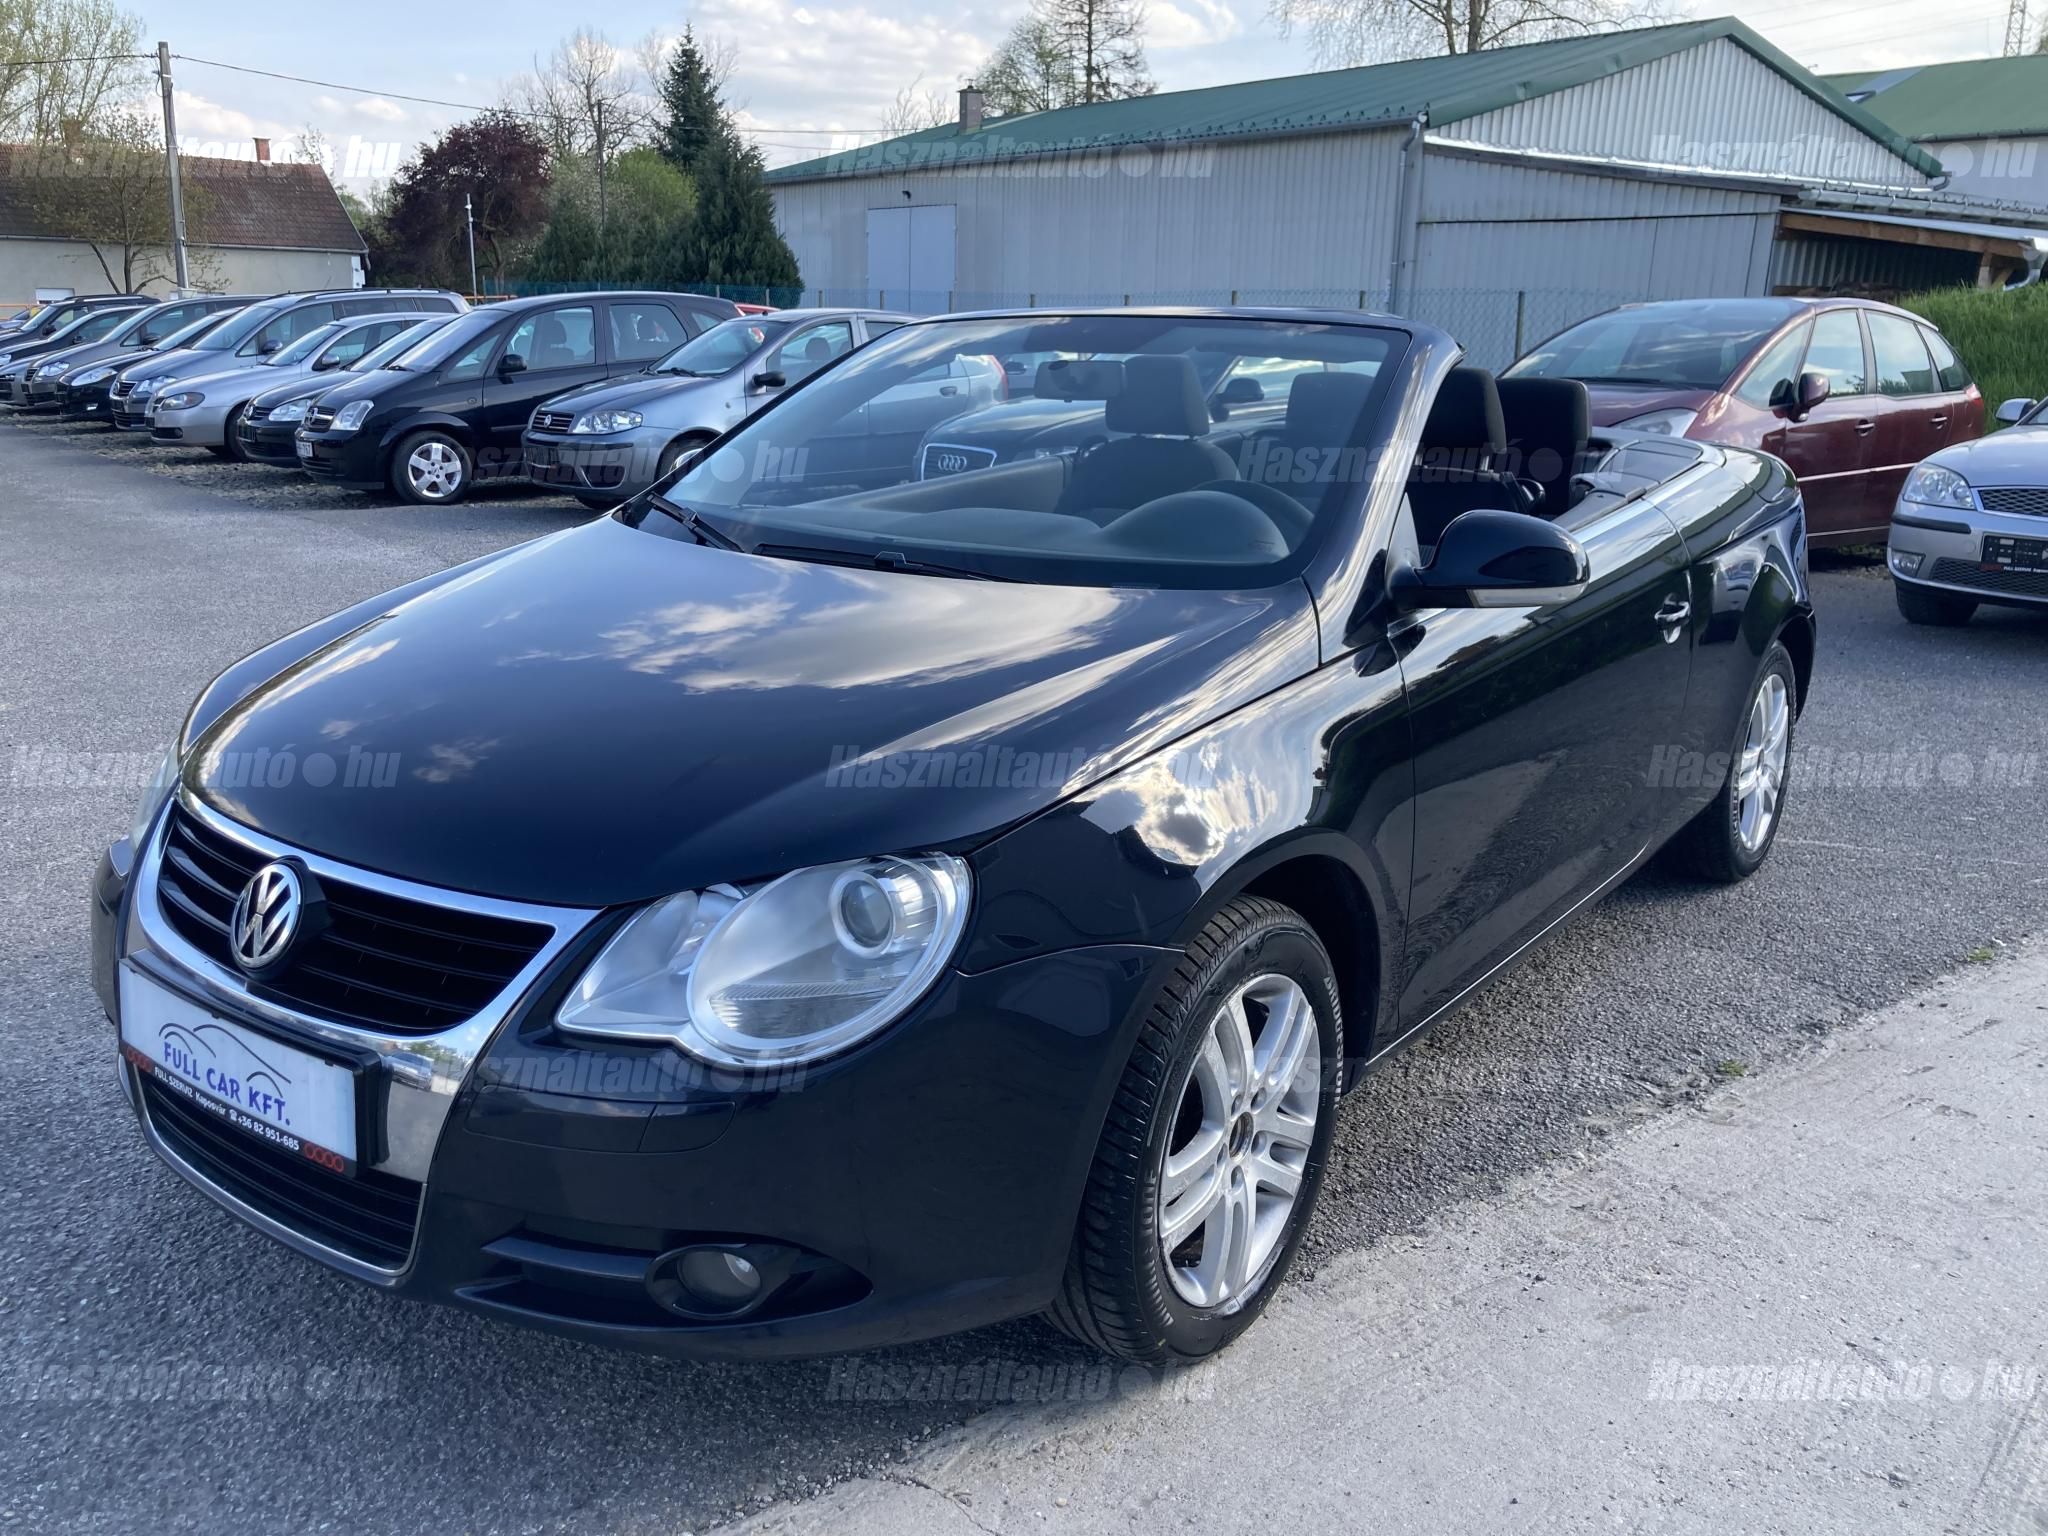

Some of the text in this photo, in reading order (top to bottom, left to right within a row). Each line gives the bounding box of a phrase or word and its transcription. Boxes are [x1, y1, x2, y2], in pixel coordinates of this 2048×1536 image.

[154, 1066, 169, 1082] FULL
[253, 1121, 265, 1135] 82
[265, 1126, 300, 1151] 951-685
[164, 1041, 291, 1126] FULL CAR KFT.
